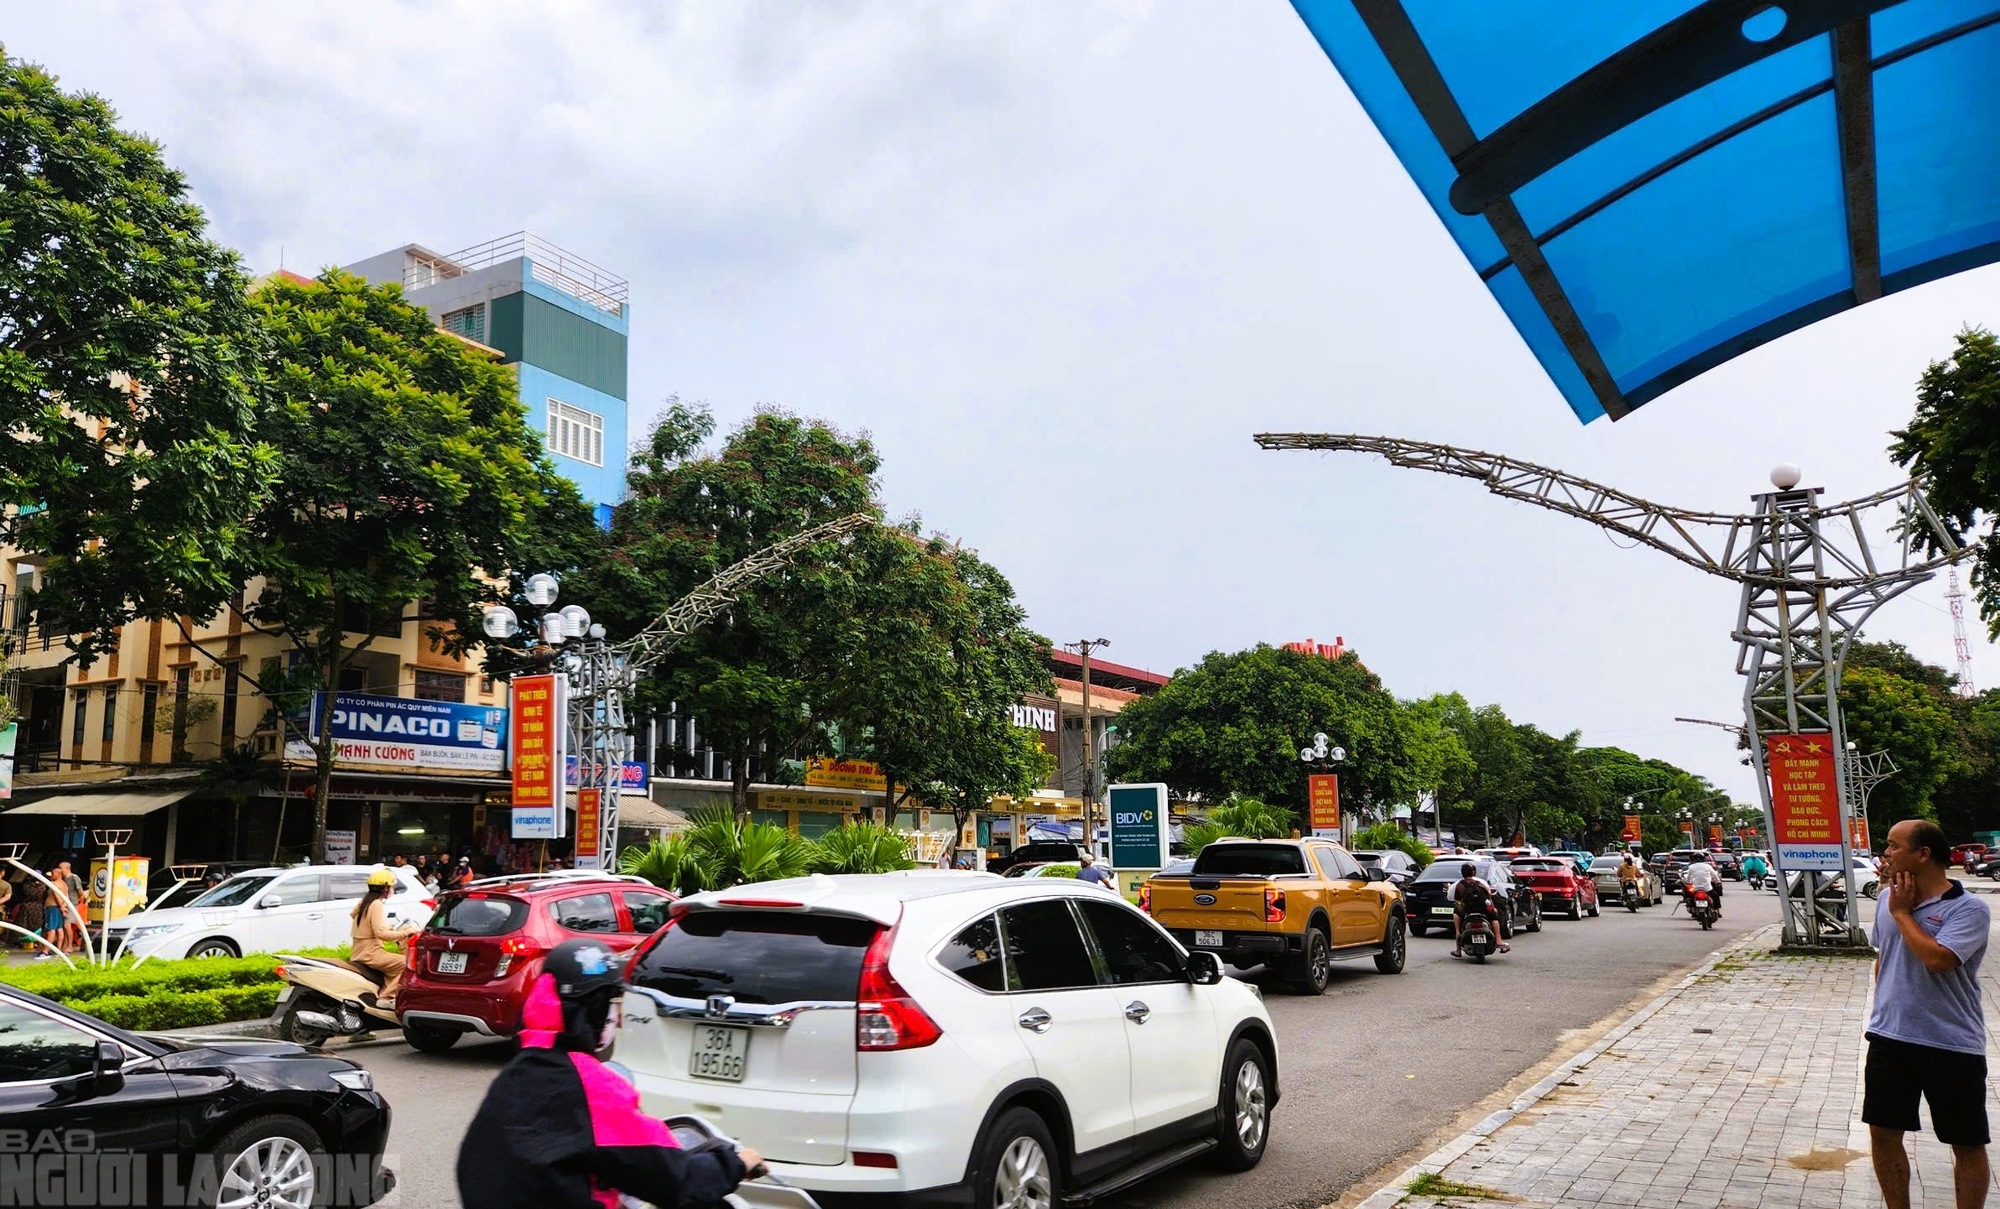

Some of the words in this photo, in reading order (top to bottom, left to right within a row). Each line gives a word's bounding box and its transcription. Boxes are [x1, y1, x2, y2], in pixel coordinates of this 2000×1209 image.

[407, 703, 421, 711] QUY
[438, 706, 451, 714] NAM
[332, 710, 450, 738] PINACO
[334, 743, 371, 760] MẠNH
[374, 744, 415, 760] CƯỜNG
[1799, 759, 1819, 769] MẠNH
[532, 770, 545, 780] NAM
[858, 765, 872, 775] THU
[1789, 771, 1803, 780] HỌC
[1804, 770, 1817, 780] TẬP
[1783, 782, 1792, 791] VÀ
[1792, 782, 1808, 791] LÀM
[1808, 783, 1826, 791] THEO
[1788, 794, 1798, 803] TƯ
[514, 816, 551, 826] vinaphone
[1116, 812, 1143, 824] BIDV
[1786, 818, 1810, 826] PHONG
[1810, 816, 1829, 826] CÁCH
[1786, 828, 1796, 838] HỒ
[1797, 829, 1809, 838] CHÍ
[1810, 830, 1831, 838] MINH!
[1783, 850, 1839, 859] vinaphone
[705, 1028, 733, 1052] 36A
[693, 1051, 743, 1078] 195.66
